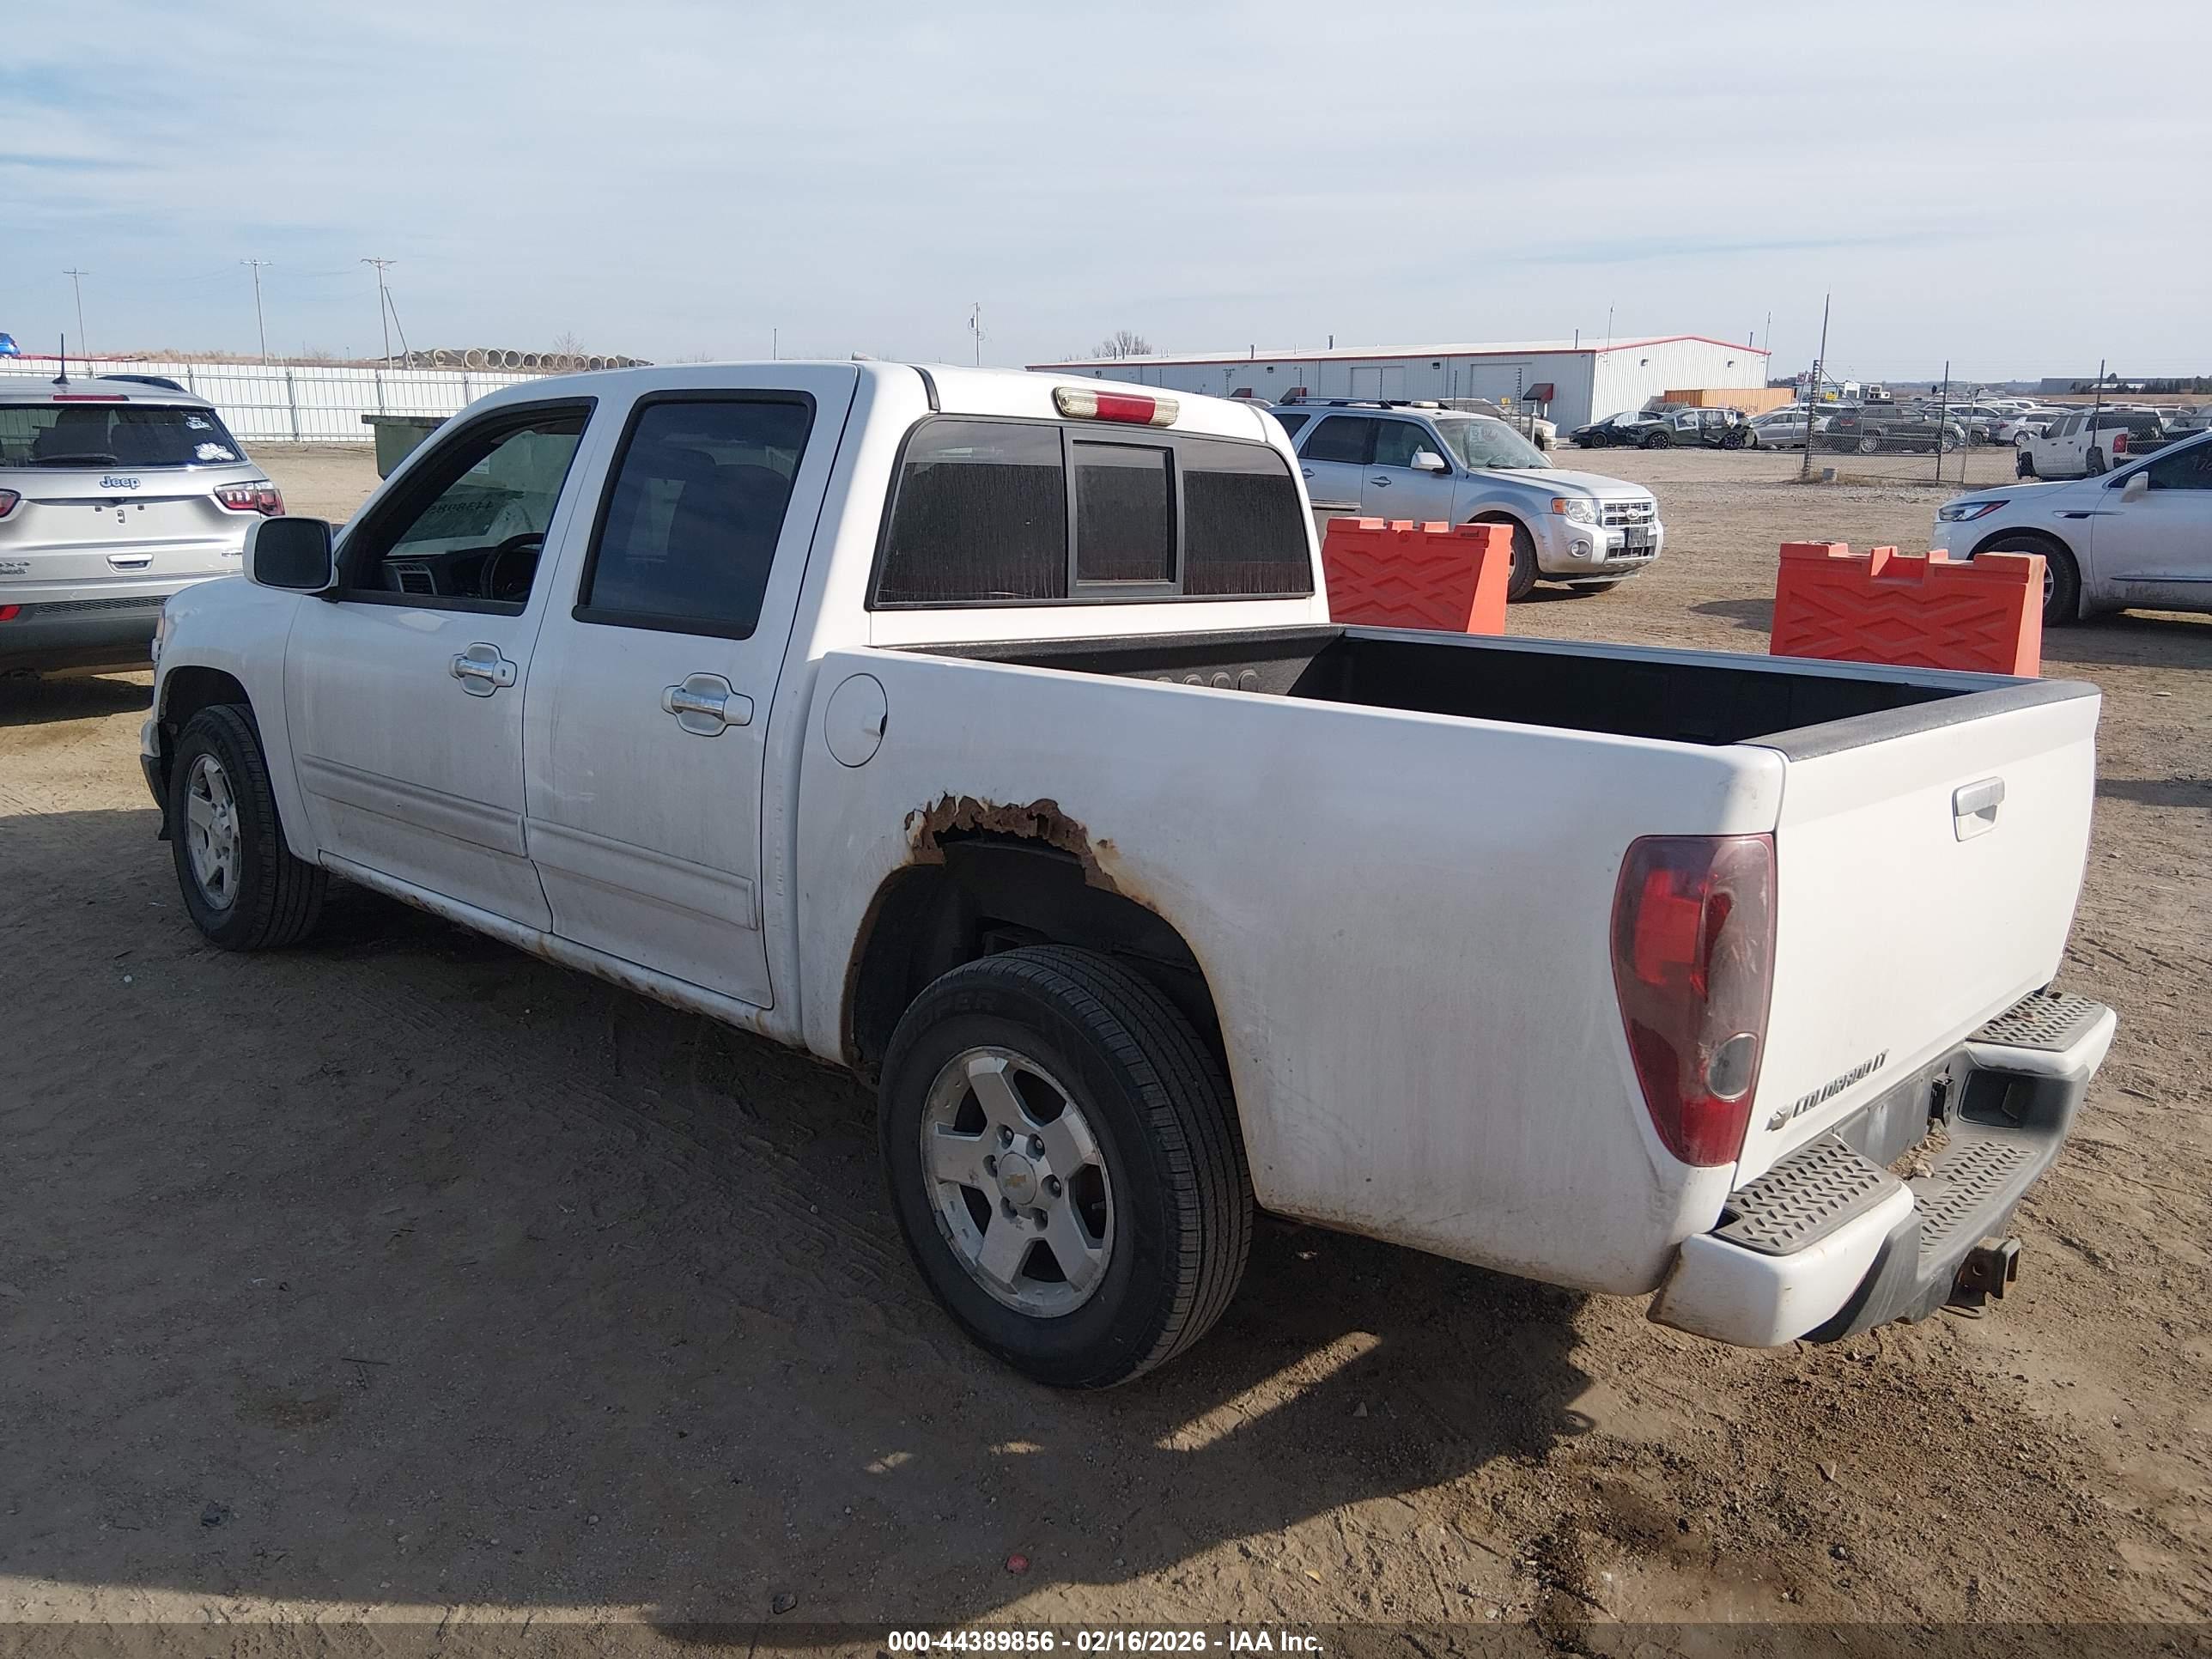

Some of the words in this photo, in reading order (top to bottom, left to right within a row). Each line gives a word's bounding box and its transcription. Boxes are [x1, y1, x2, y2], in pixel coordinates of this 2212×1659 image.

[100, 475, 141, 489] Jeep
[1792, 1059, 1873, 1118] COLORADO
[1873, 1048, 1890, 1073] LT
